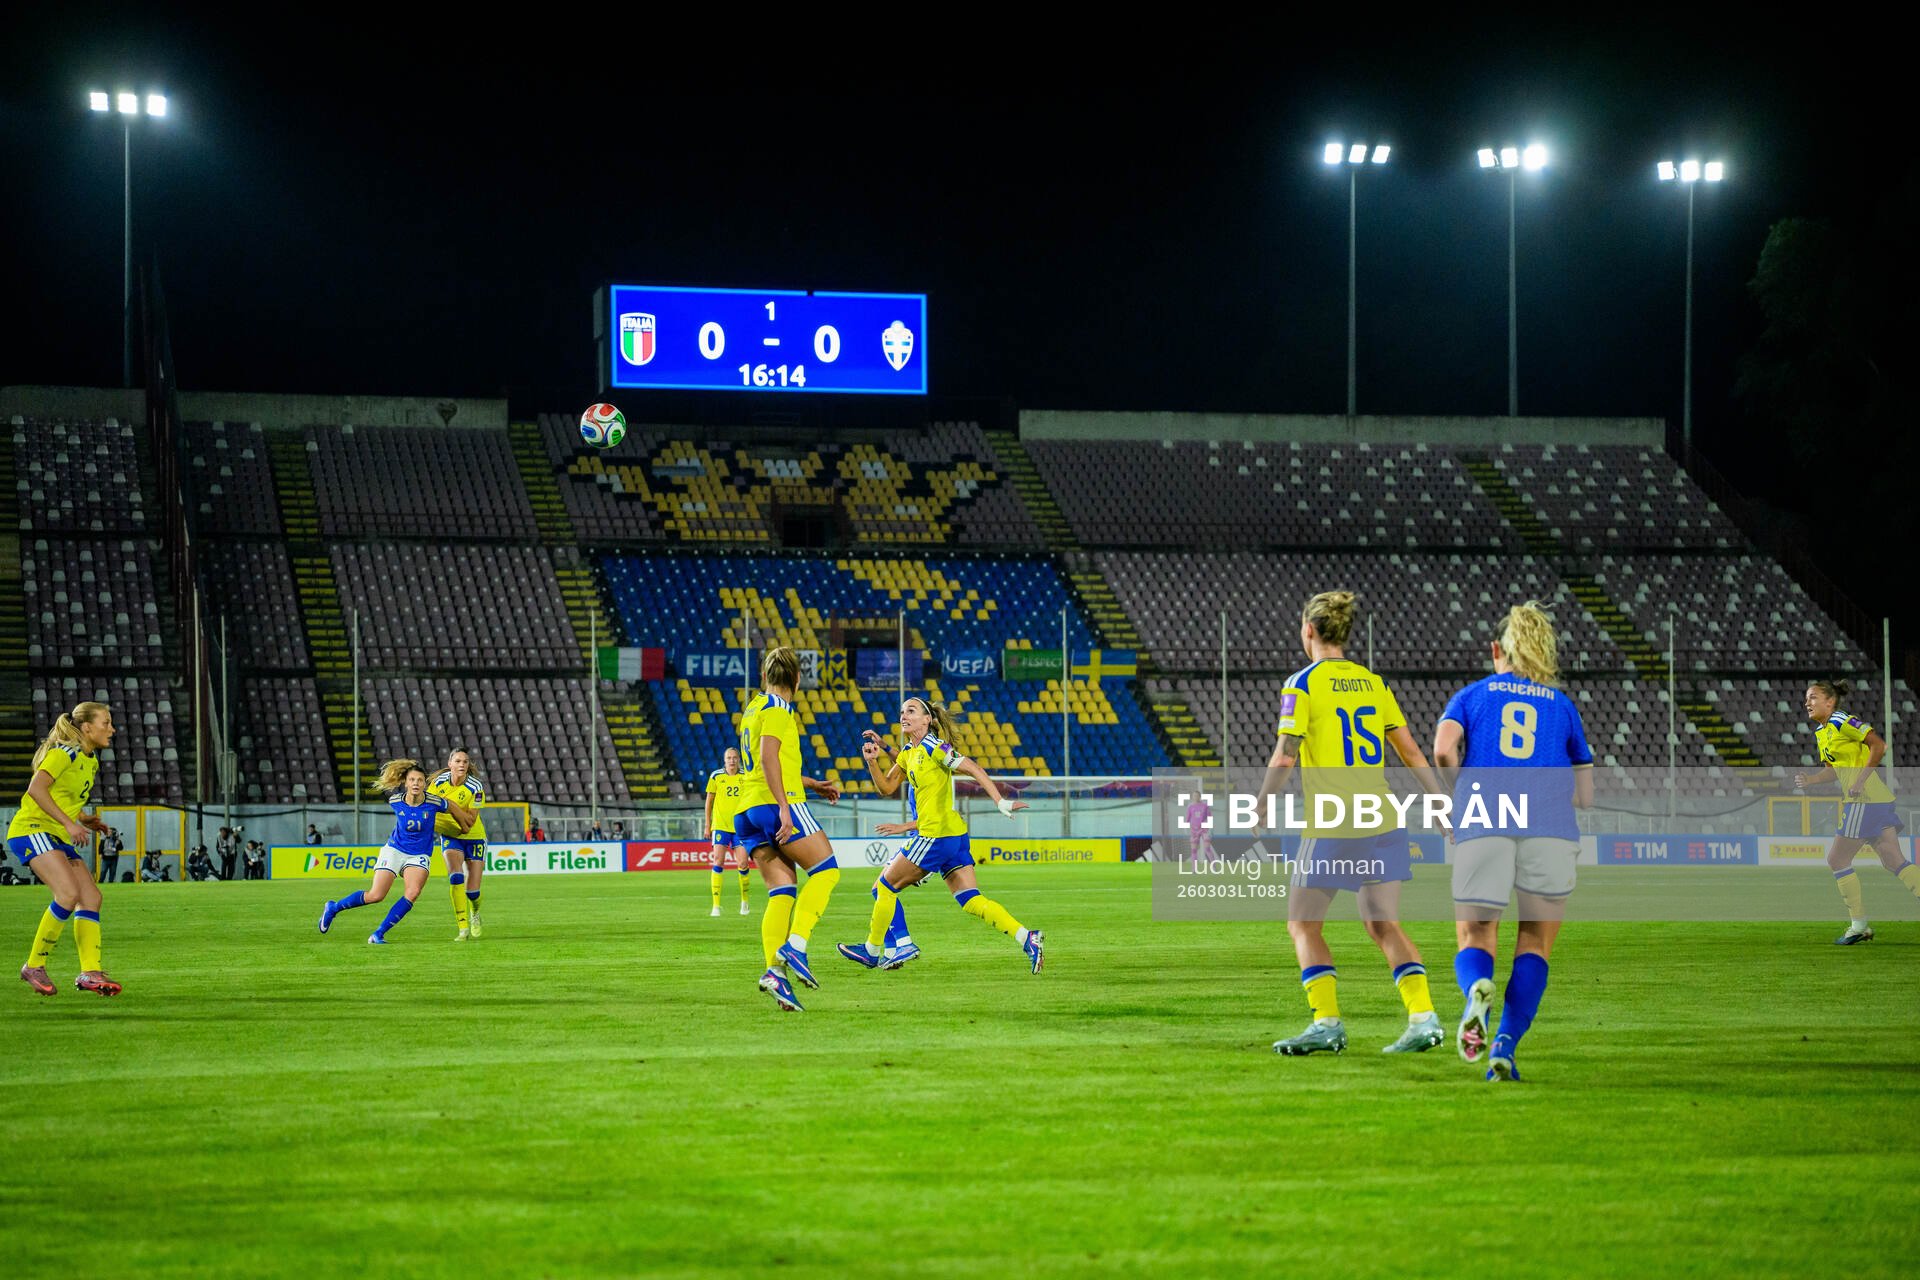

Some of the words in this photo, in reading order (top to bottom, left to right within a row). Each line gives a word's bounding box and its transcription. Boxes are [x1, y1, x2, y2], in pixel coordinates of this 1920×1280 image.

[765, 301, 775, 321] 1
[623, 317, 652, 329] ITALIA
[698, 322, 725, 360] 0
[814, 325, 841, 363] 0
[738, 364, 806, 387] 16:14
[686, 654, 745, 676] FIFA
[945, 654, 995, 674] UEFA
[1329, 678, 1374, 692] ZIGIOTTI
[1488, 681, 1555, 700] SEVERINI
[1336, 705, 1382, 767] 15
[1499, 701, 1538, 759] 8
[726, 786, 740, 797] 22
[407, 820, 422, 831] 21
[473, 844, 484, 858] 13
[548, 850, 606, 870] Fileni
[1634, 842, 1668, 859] TIM
[1708, 842, 1742, 859] TIM
